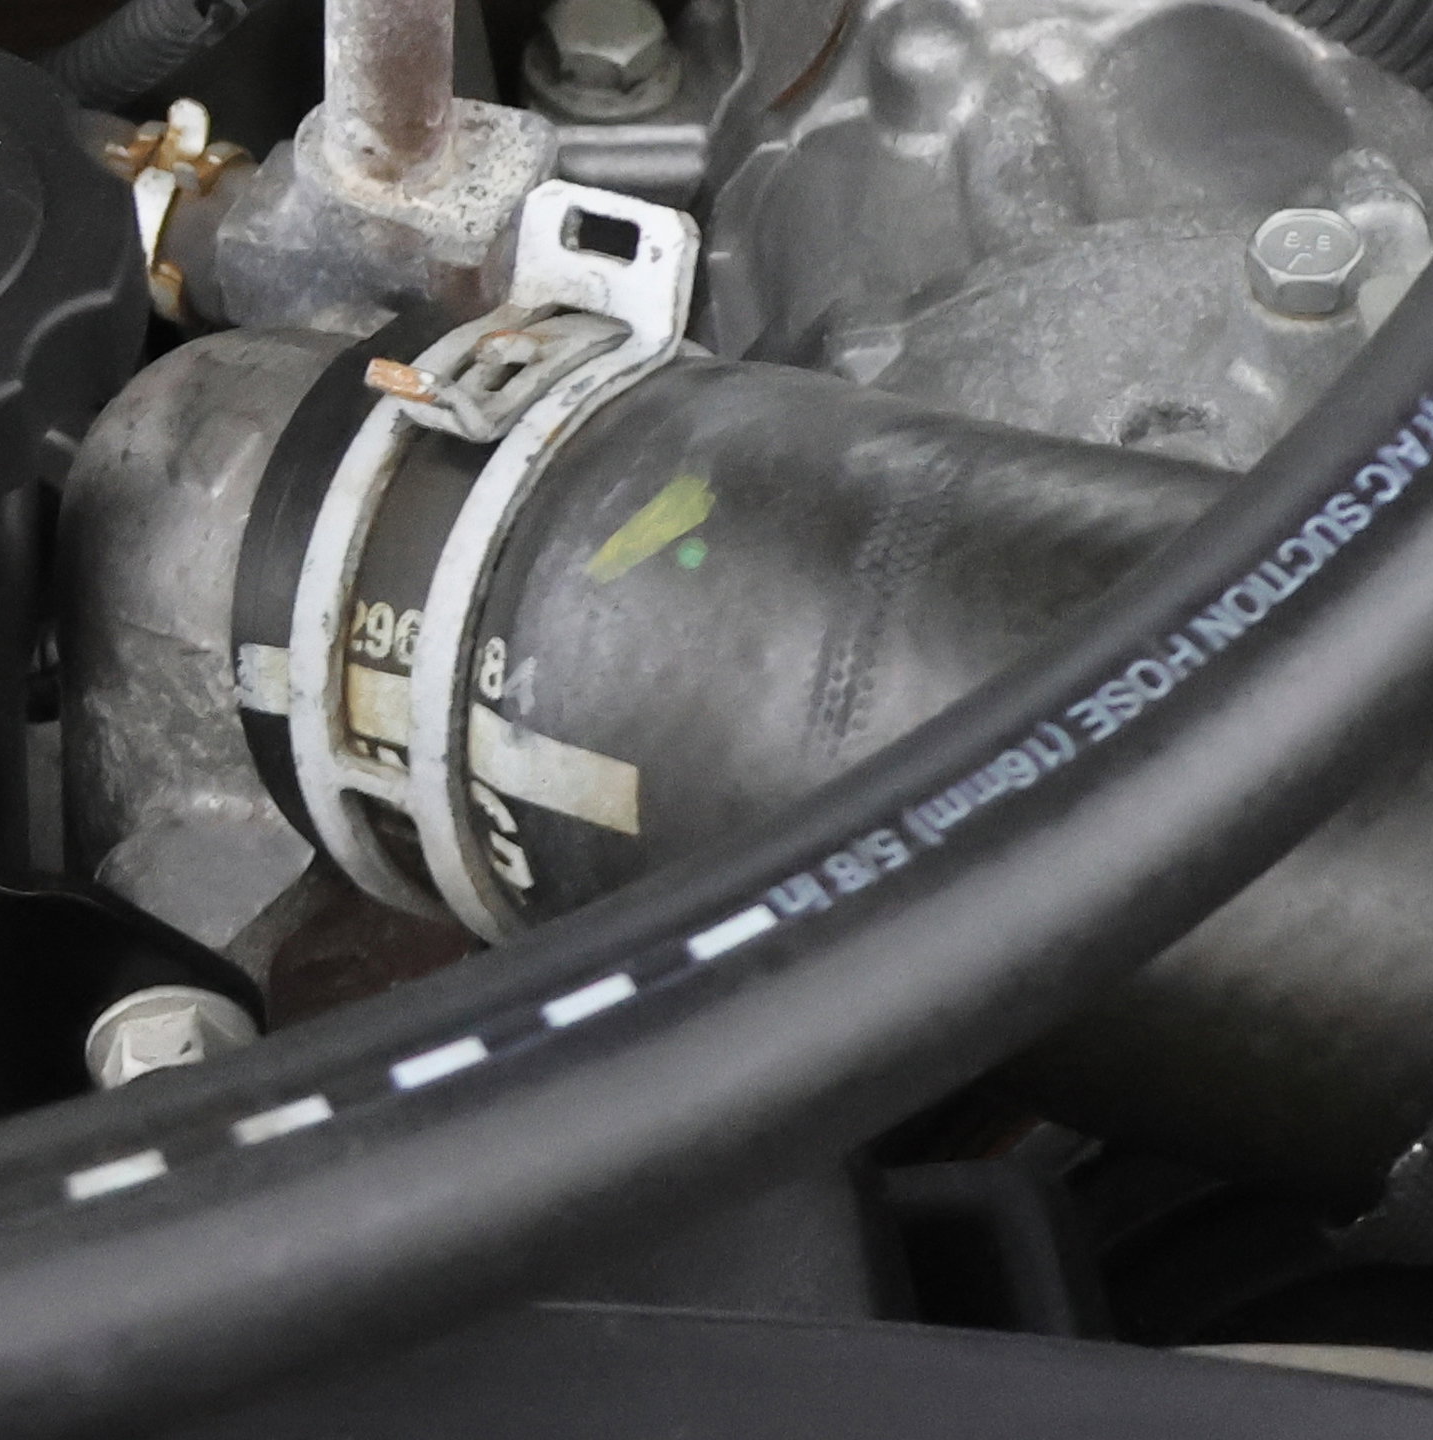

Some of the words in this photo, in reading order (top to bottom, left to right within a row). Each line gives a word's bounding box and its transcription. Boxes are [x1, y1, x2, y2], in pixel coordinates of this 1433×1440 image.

[1191, 486, 1373, 652] SUCTION
[1065, 636, 1204, 742] HOSE
[904, 719, 1077, 850] (16mm)
[766, 867, 835, 917] in
[824, 830, 910, 900] 5/8
